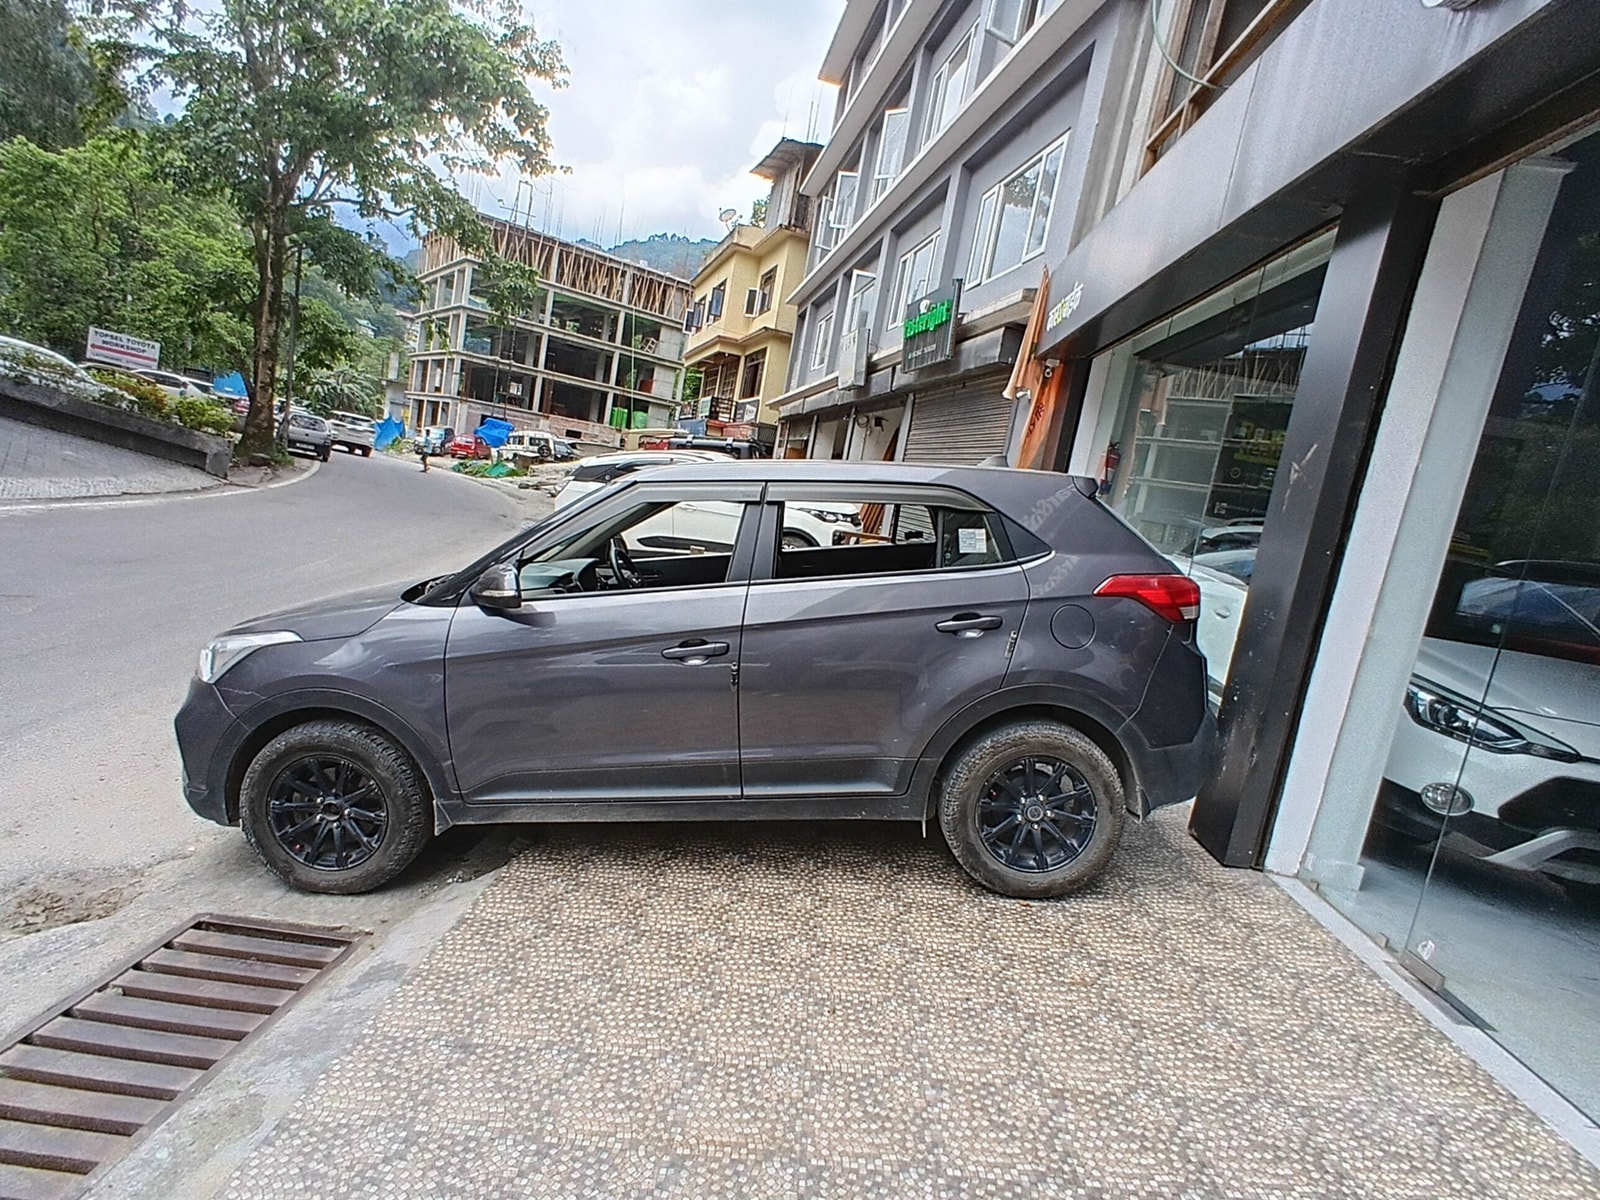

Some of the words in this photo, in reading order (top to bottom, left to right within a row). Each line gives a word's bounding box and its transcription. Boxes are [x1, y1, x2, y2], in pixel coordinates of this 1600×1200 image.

[94, 331, 124, 342] TOPSEL
[127, 338, 156, 349] TOYOTA
[102, 340, 147, 354] WORKSHOP
